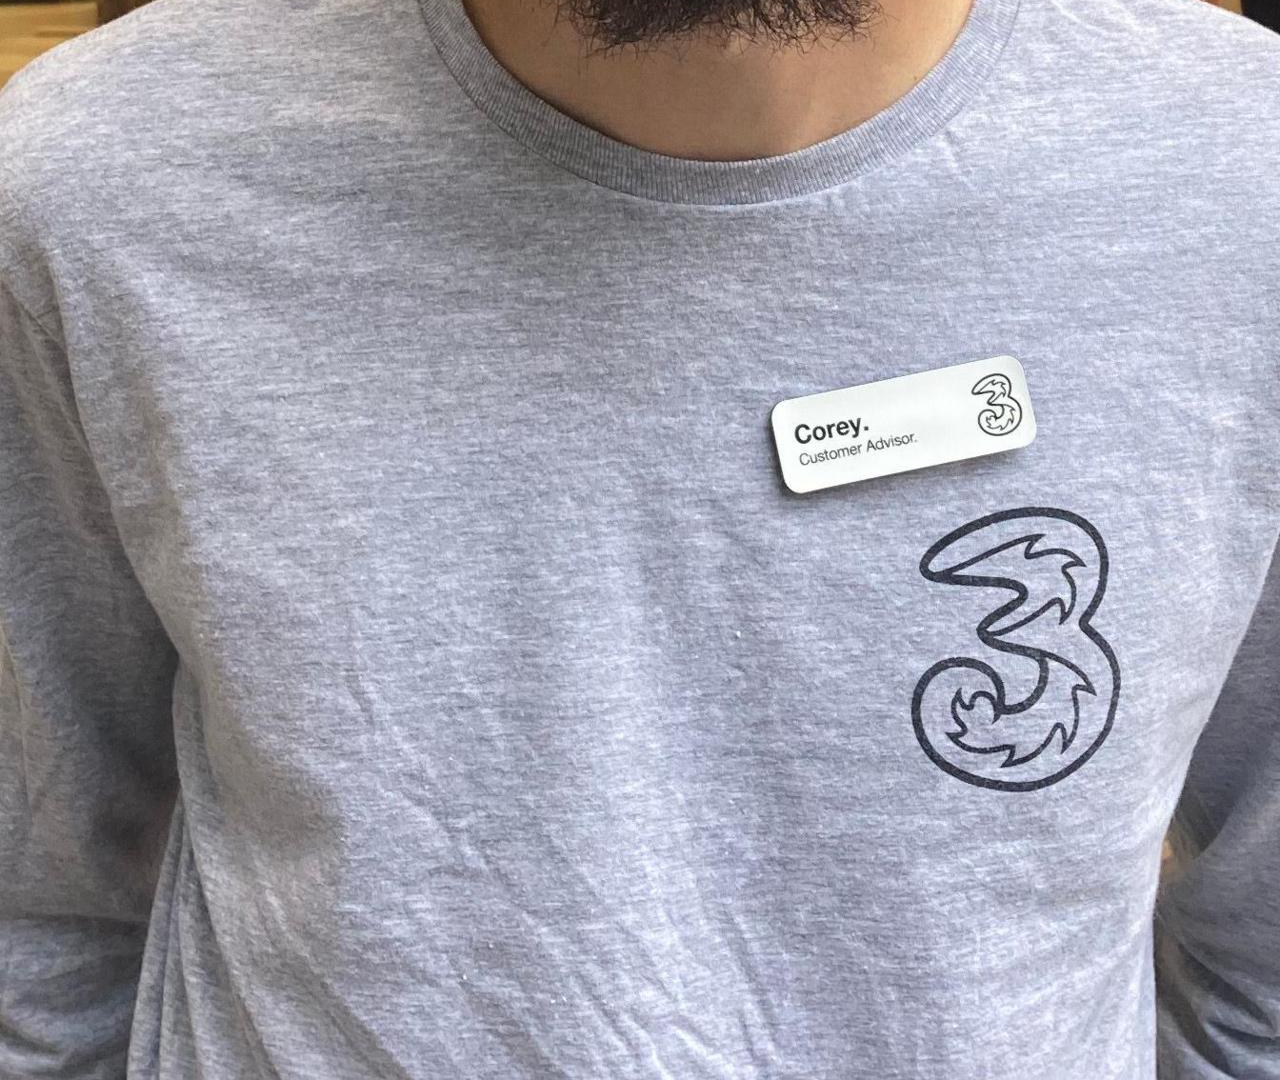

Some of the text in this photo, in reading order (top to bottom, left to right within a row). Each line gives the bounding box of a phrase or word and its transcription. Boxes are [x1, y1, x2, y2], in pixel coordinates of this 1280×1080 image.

[794, 417, 870, 444] Corey.
[799, 432, 918, 466] Customer Advisor.
